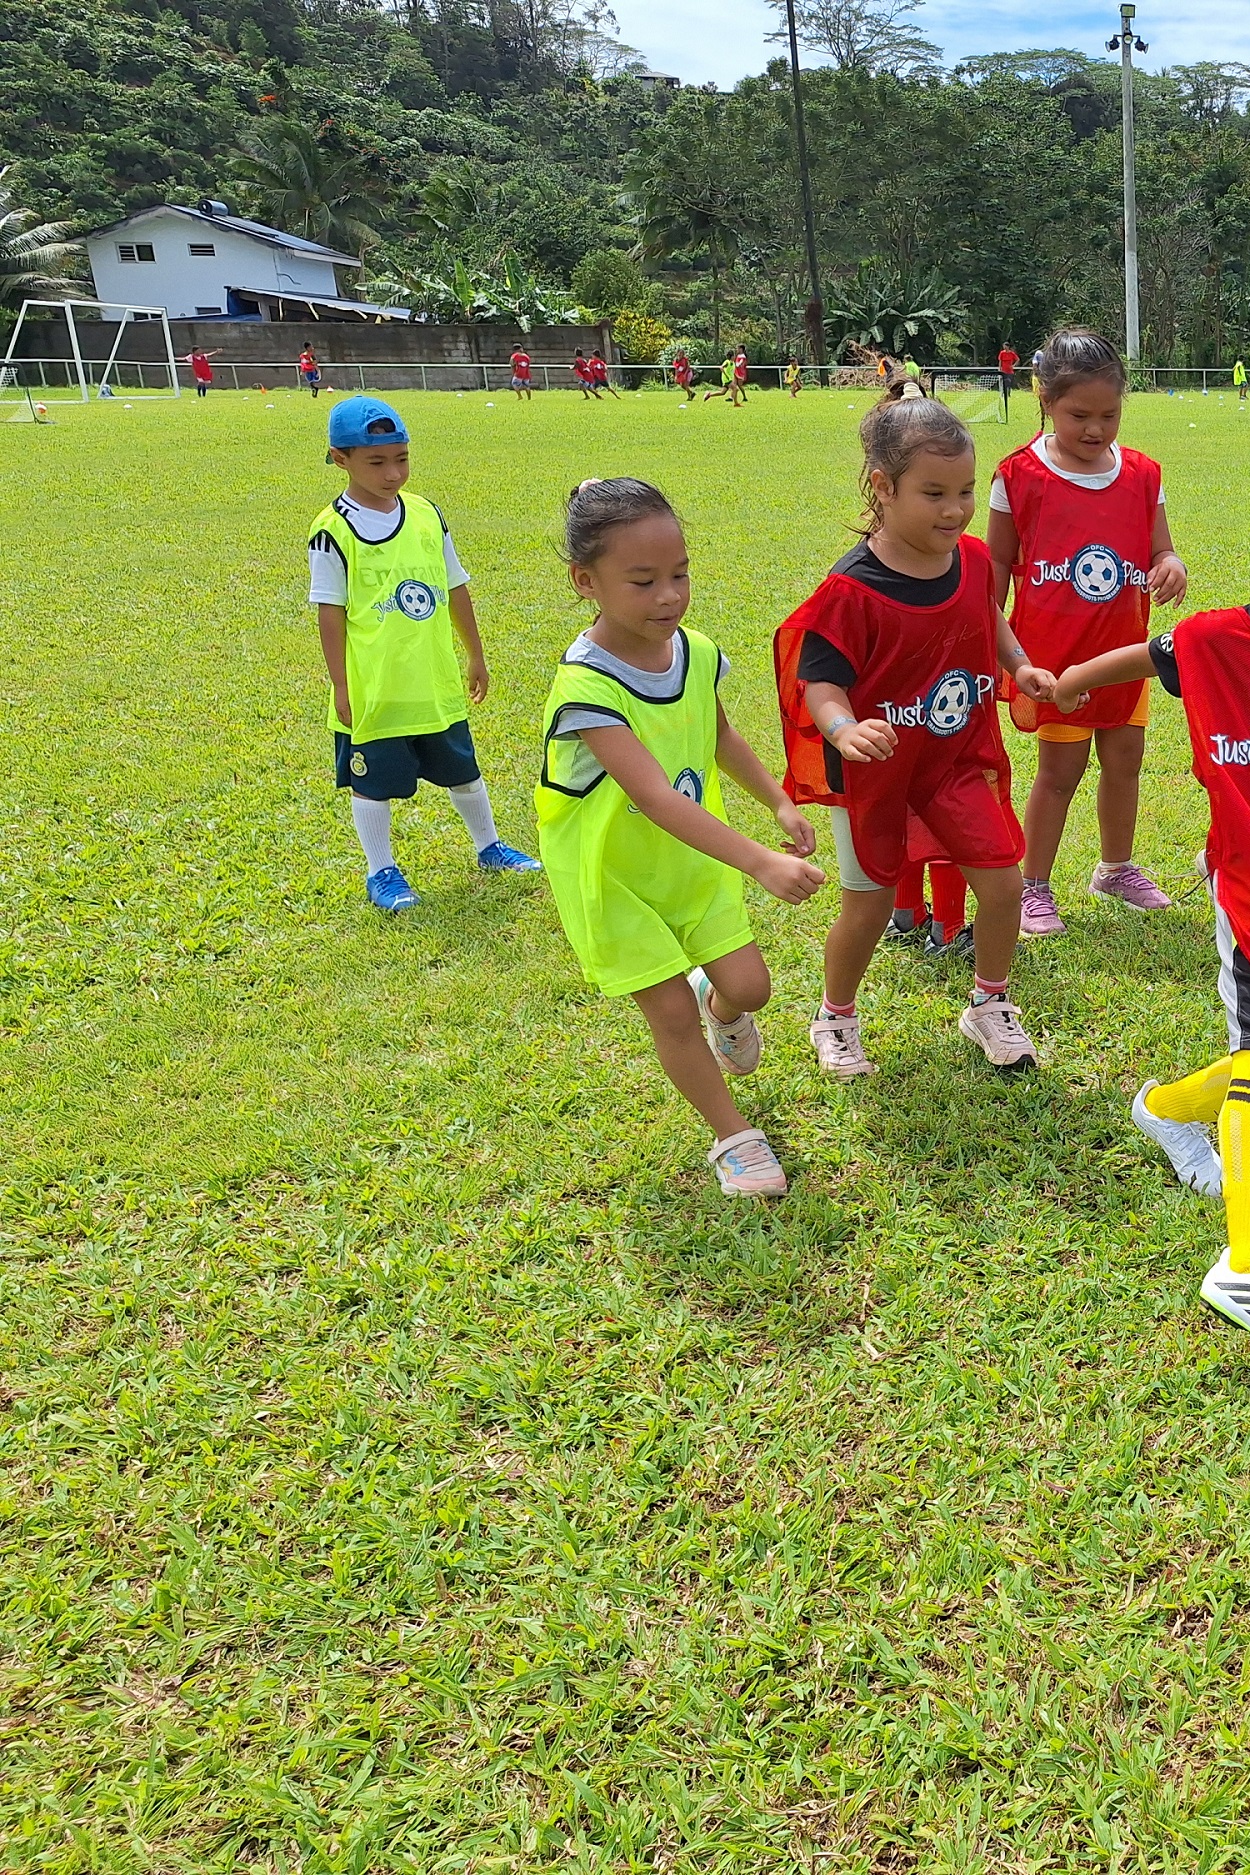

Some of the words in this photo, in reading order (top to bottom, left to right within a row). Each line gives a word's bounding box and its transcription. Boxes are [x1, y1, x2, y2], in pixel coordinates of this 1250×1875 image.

[1089, 544, 1105, 552] OFC
[1031, 557, 1071, 586] Just
[1122, 560, 1150, 594] Play
[943, 669, 960, 680] OFC
[876, 697, 927, 728] Just
[974, 674, 995, 704] Pl
